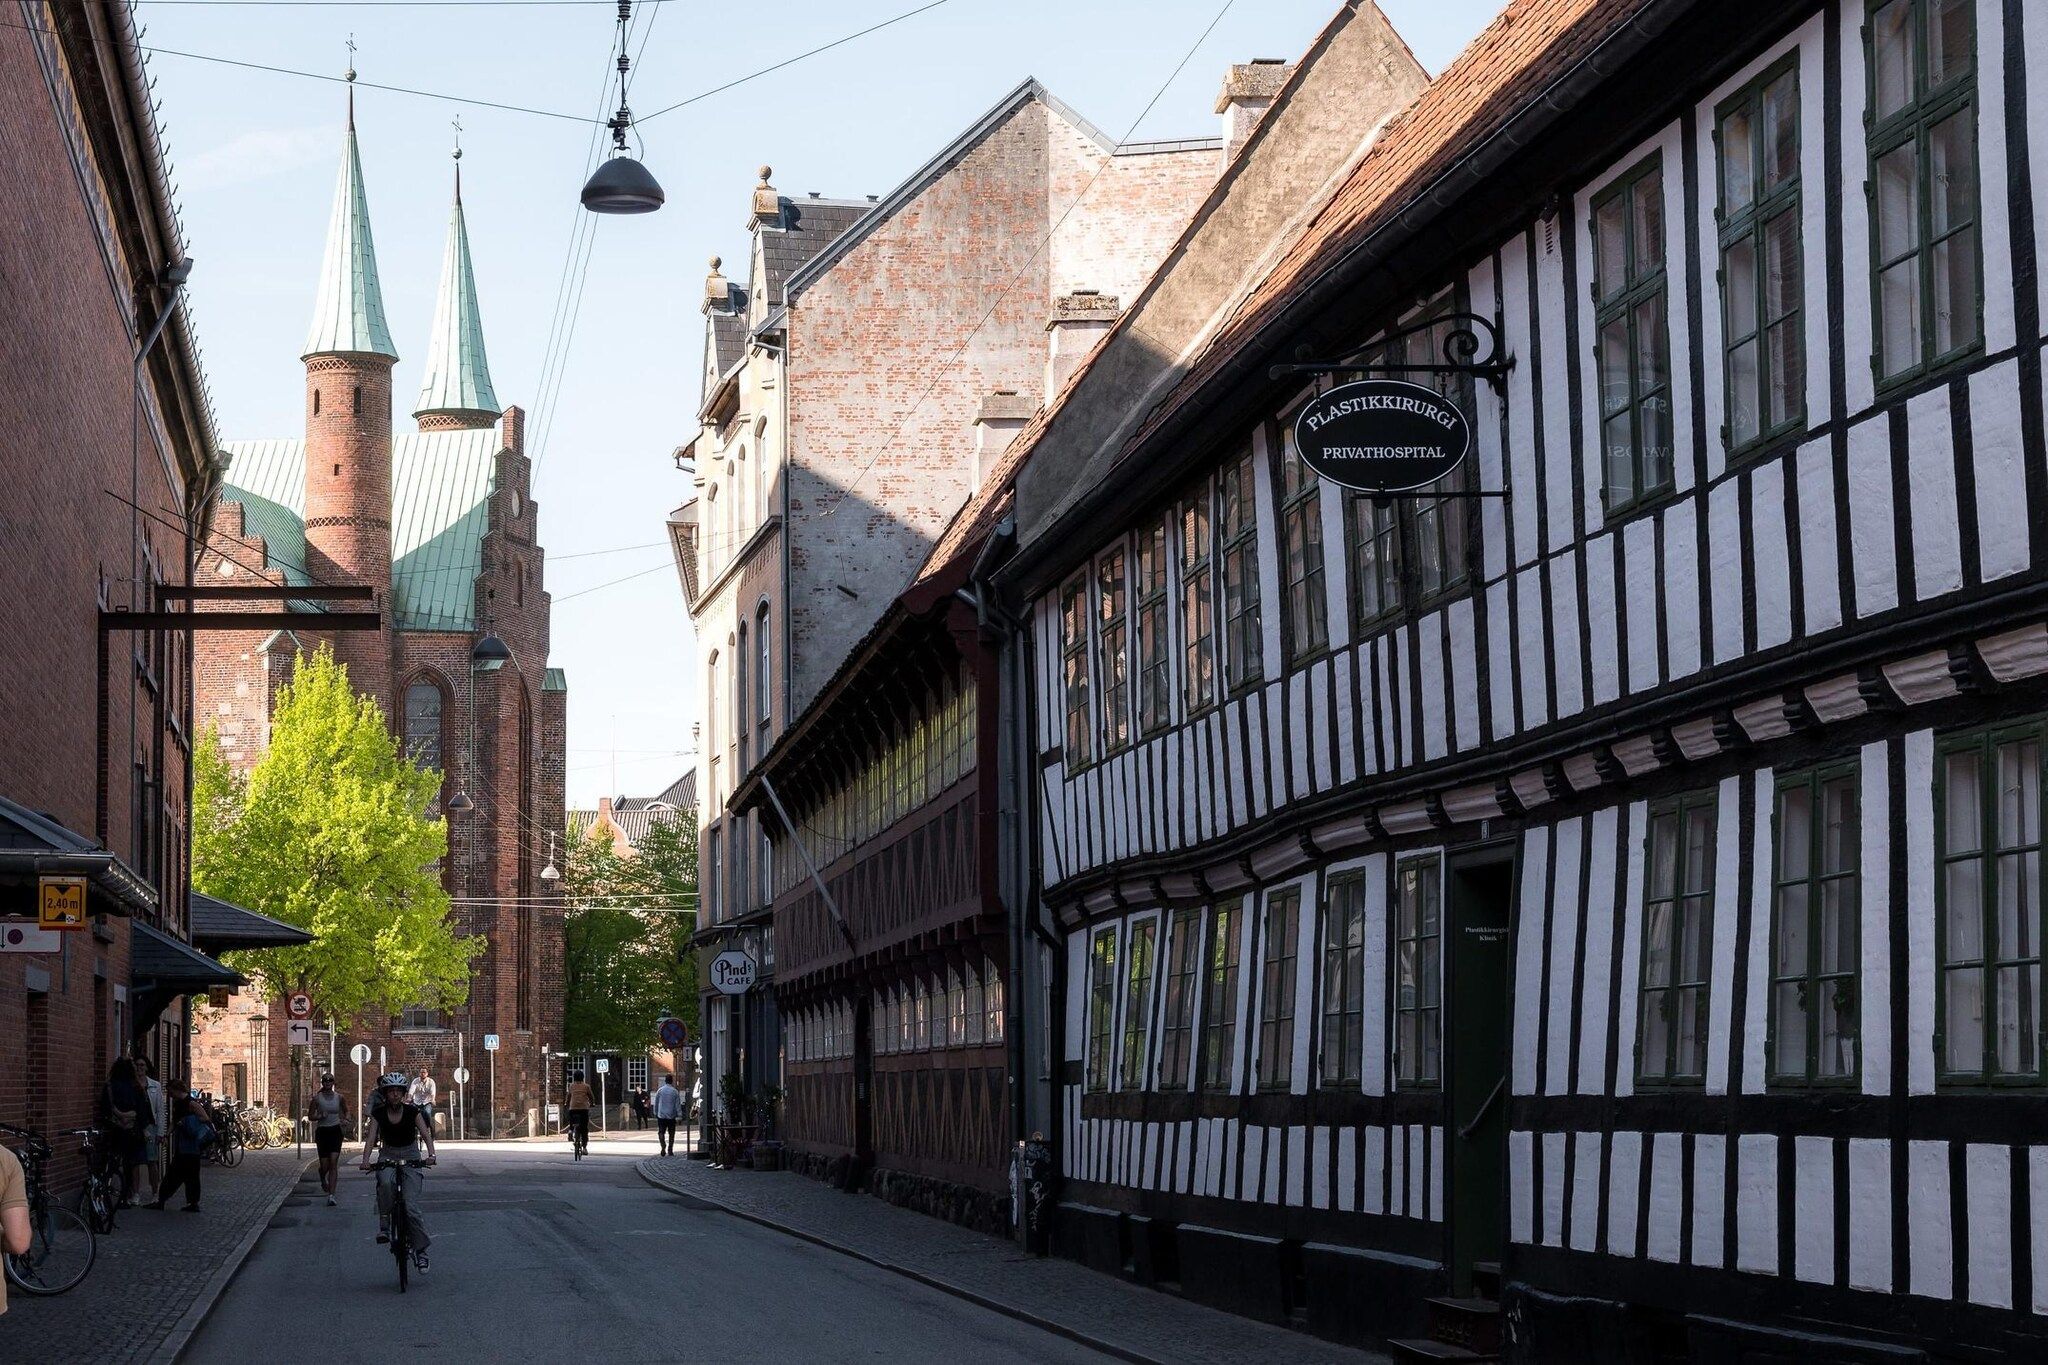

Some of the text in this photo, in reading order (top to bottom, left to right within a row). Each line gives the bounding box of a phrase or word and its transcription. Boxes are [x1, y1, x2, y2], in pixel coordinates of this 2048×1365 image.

[1306, 395, 1458, 432] PLASTIKKIRURGI
[1323, 447, 1446, 459] PRIVATHOSPITAL
[47, 898, 78, 910] 2,40 m
